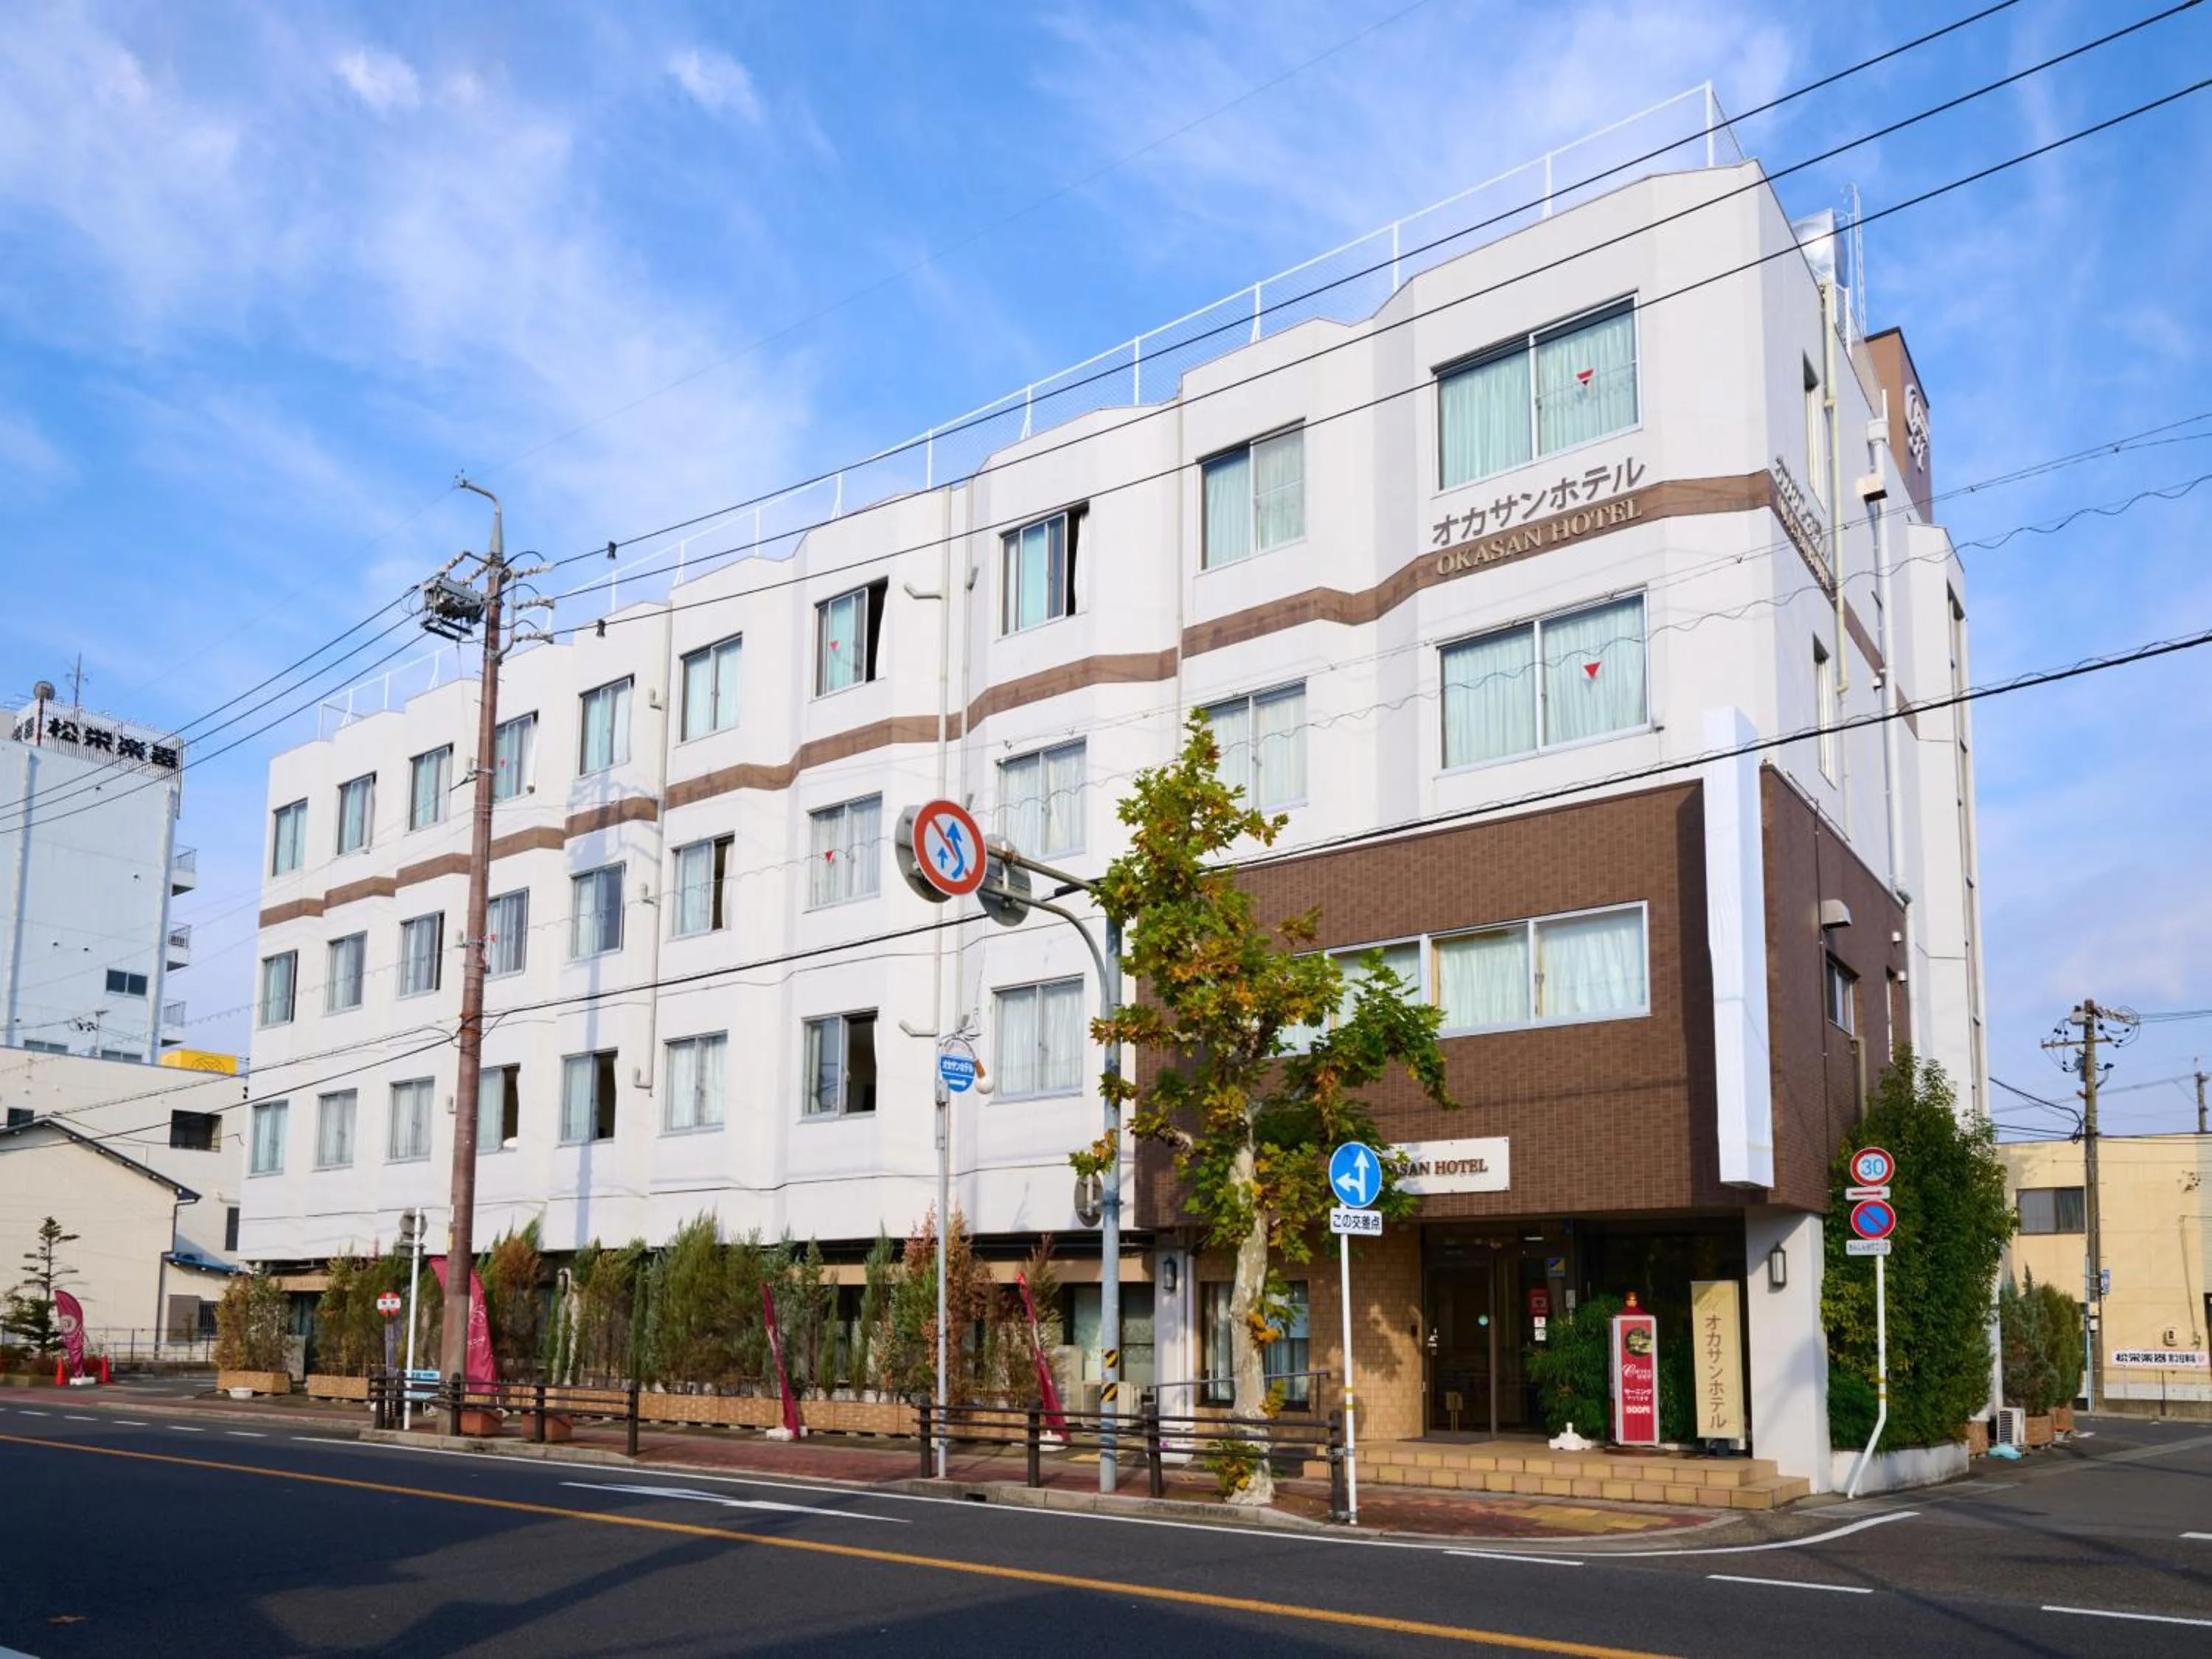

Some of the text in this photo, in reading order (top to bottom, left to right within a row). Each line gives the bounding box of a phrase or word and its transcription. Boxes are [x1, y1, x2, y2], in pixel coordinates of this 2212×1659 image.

[1431, 456, 1646, 546] オカサンホテル
[1437, 497, 1644, 575] OKASAN HOTEL
[1434, 1158, 1489, 1175] HOTEL
[1860, 1158, 1885, 1176] 30
[1333, 1214, 1381, 1230] この交差点
[1705, 1313, 1728, 1430] オカサンホテル
